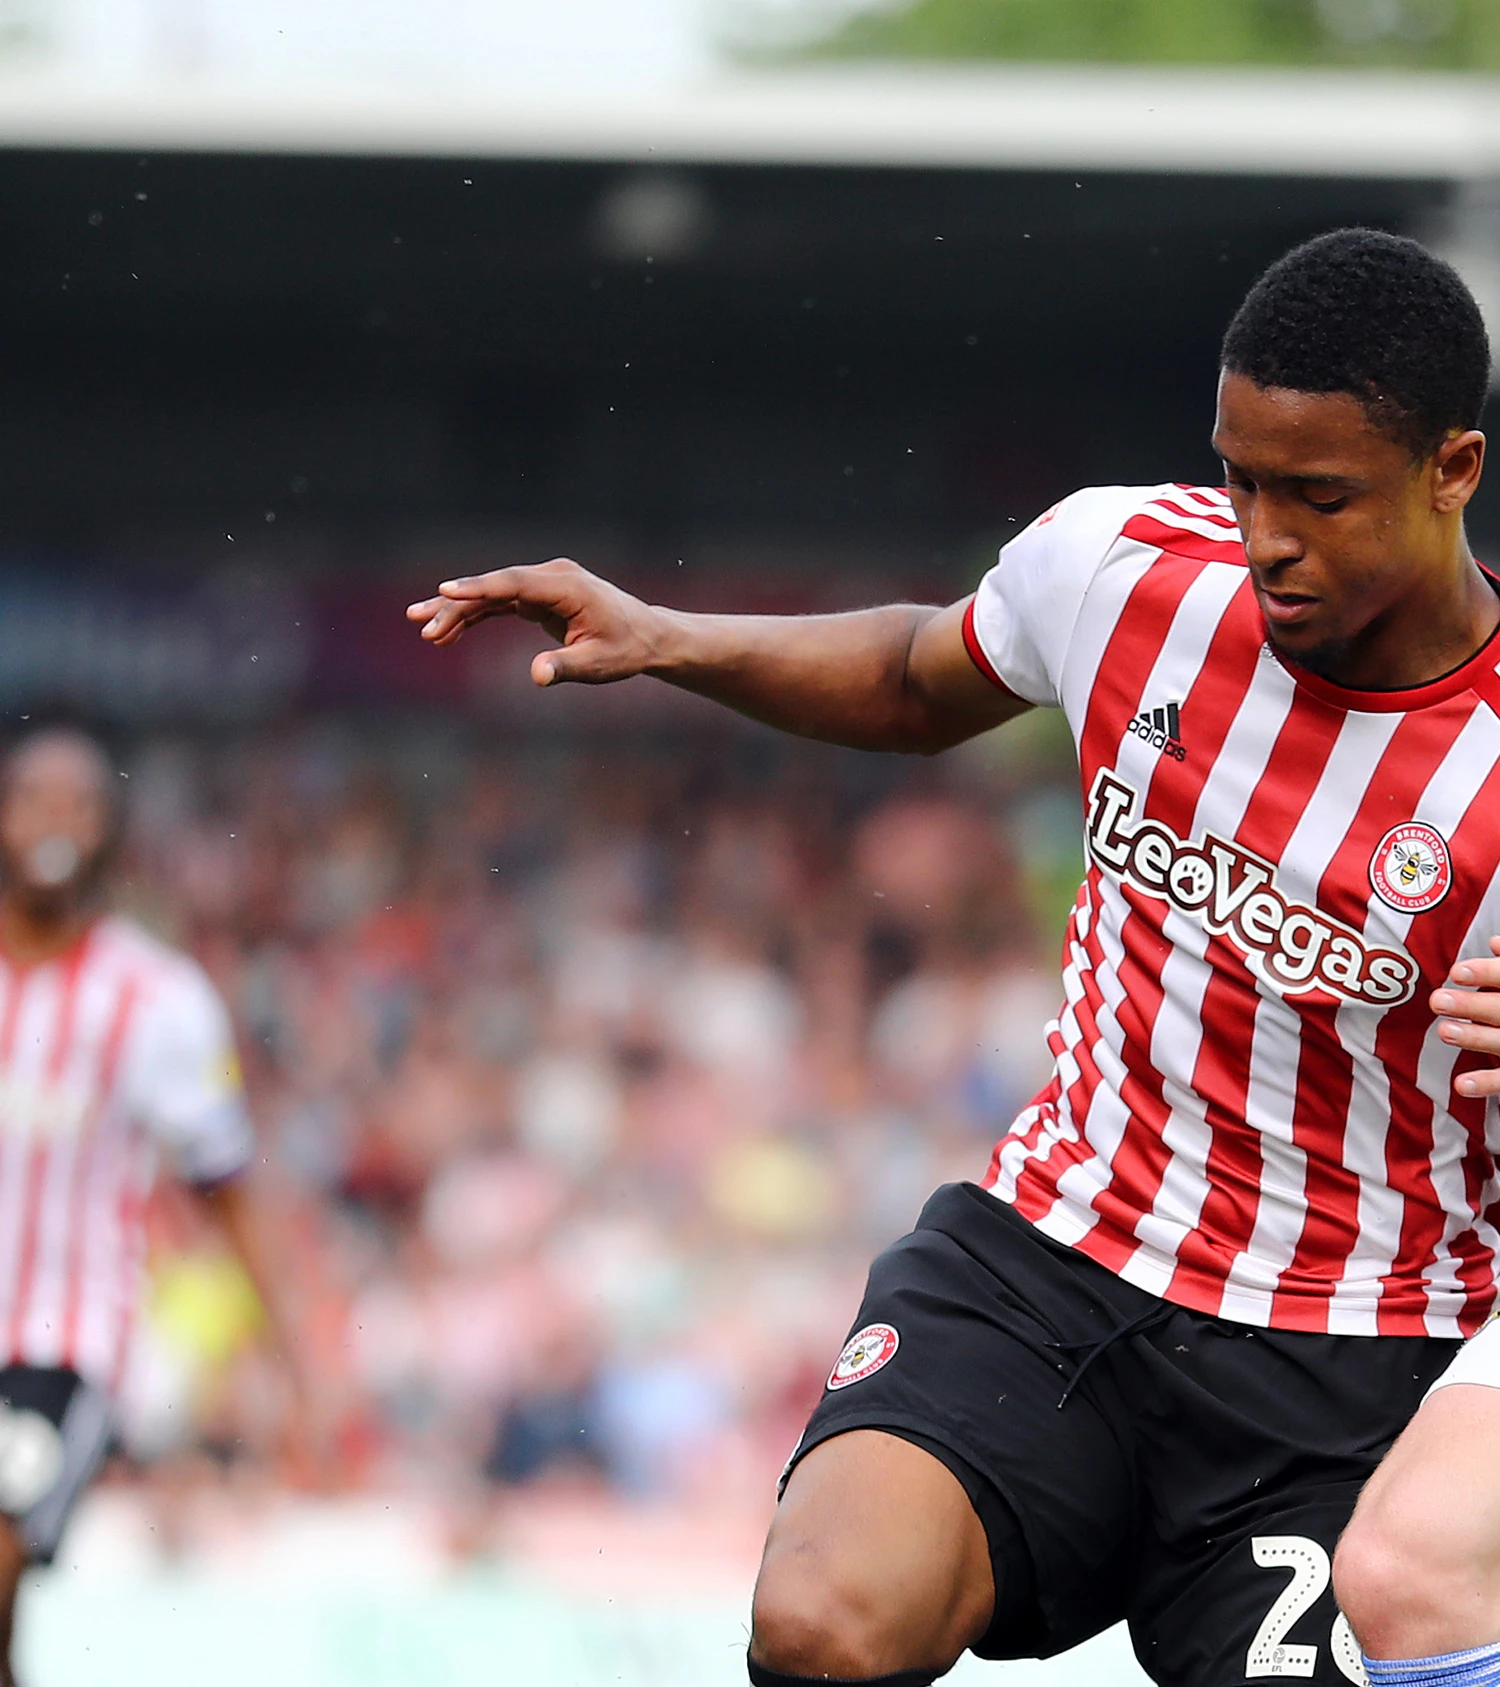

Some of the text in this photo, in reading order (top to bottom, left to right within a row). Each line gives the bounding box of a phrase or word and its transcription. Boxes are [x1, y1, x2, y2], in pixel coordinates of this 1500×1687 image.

[1127, 719, 1187, 762] adidas
[1395, 829, 1446, 864] BRENTFORD
[1088, 770, 1418, 1005] LeoVegas
[1375, 871, 1431, 907] FOOTBALL CLUB
[1271, 1665, 1283, 1673] EFL
